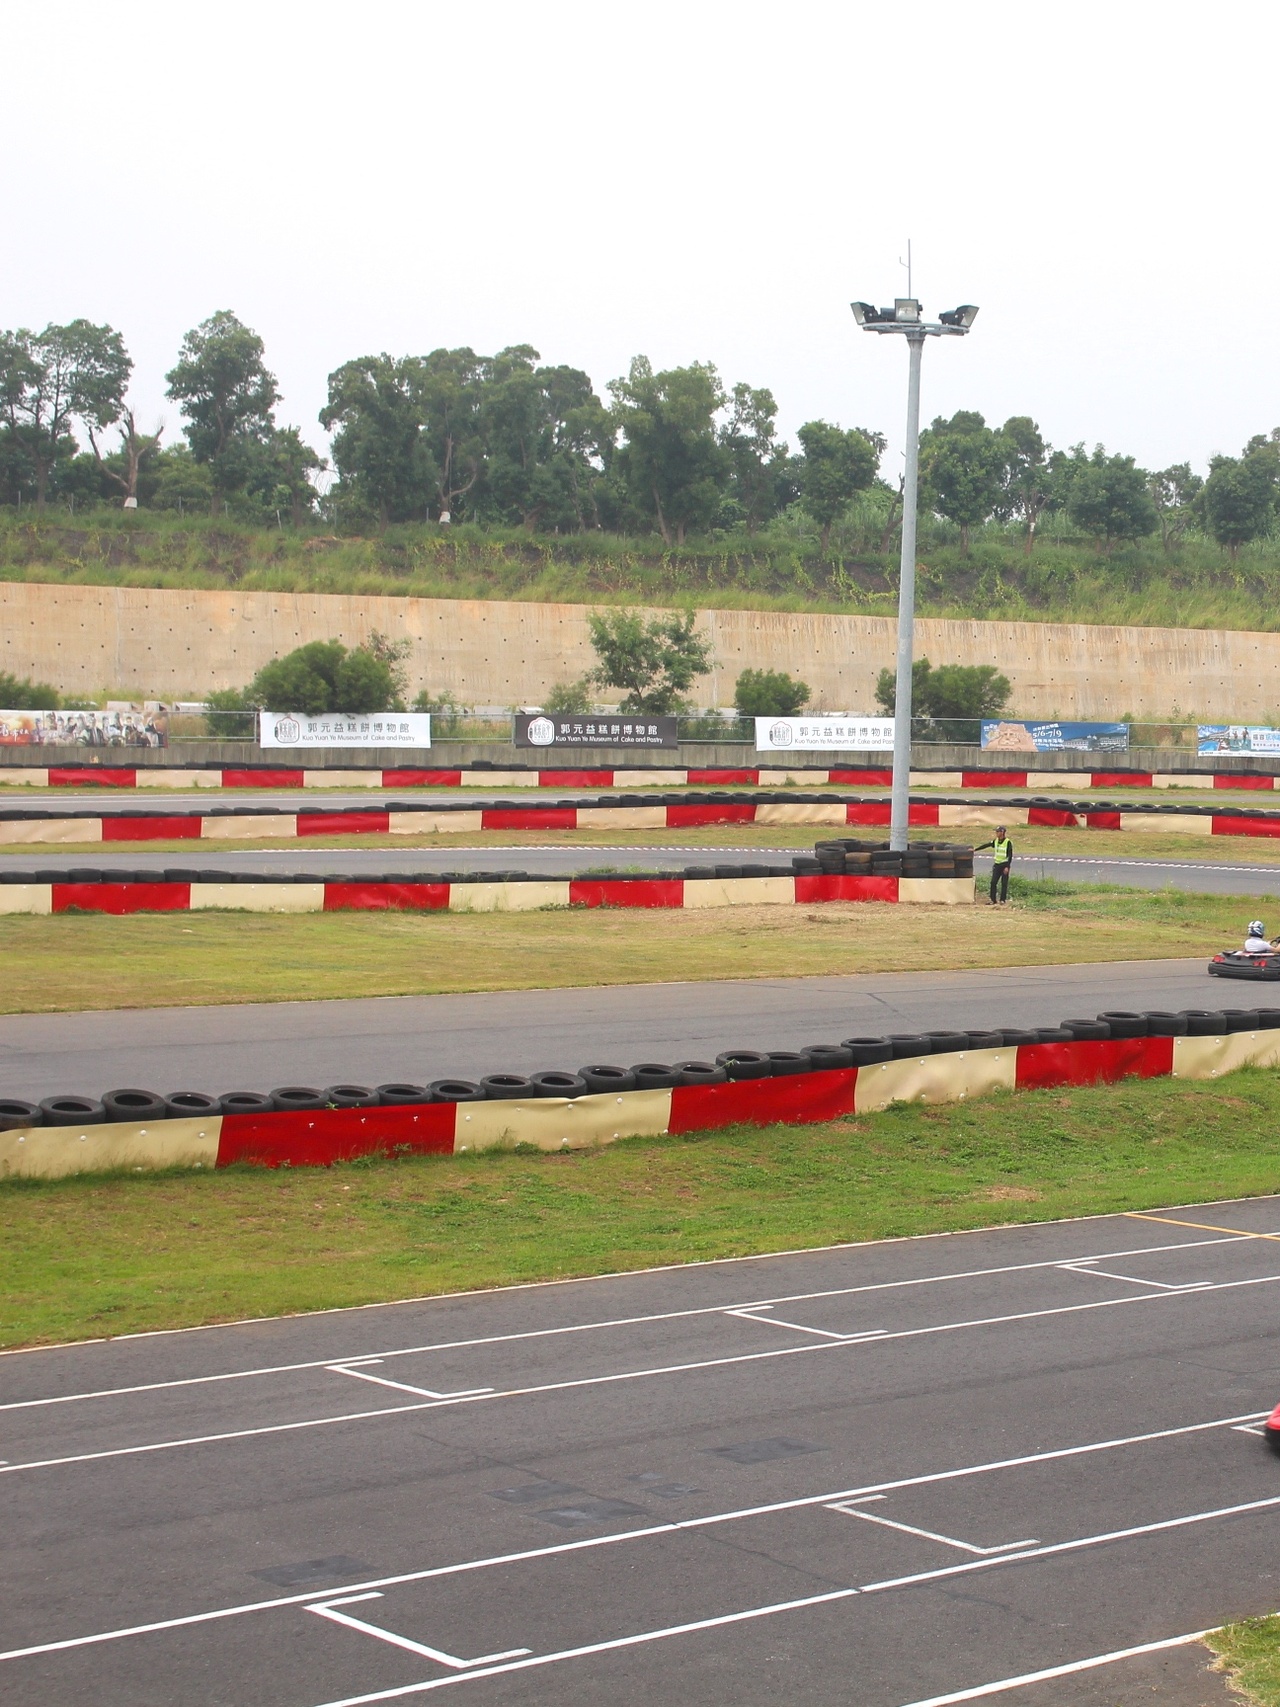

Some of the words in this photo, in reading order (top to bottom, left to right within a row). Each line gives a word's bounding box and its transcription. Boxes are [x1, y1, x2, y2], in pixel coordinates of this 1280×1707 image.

[307, 722, 410, 733] 郭元益糕餅博物館
[560, 724, 658, 734] 郭元益糕餅博物館
[800, 727, 892, 737] 郭元益糕餅博物館
